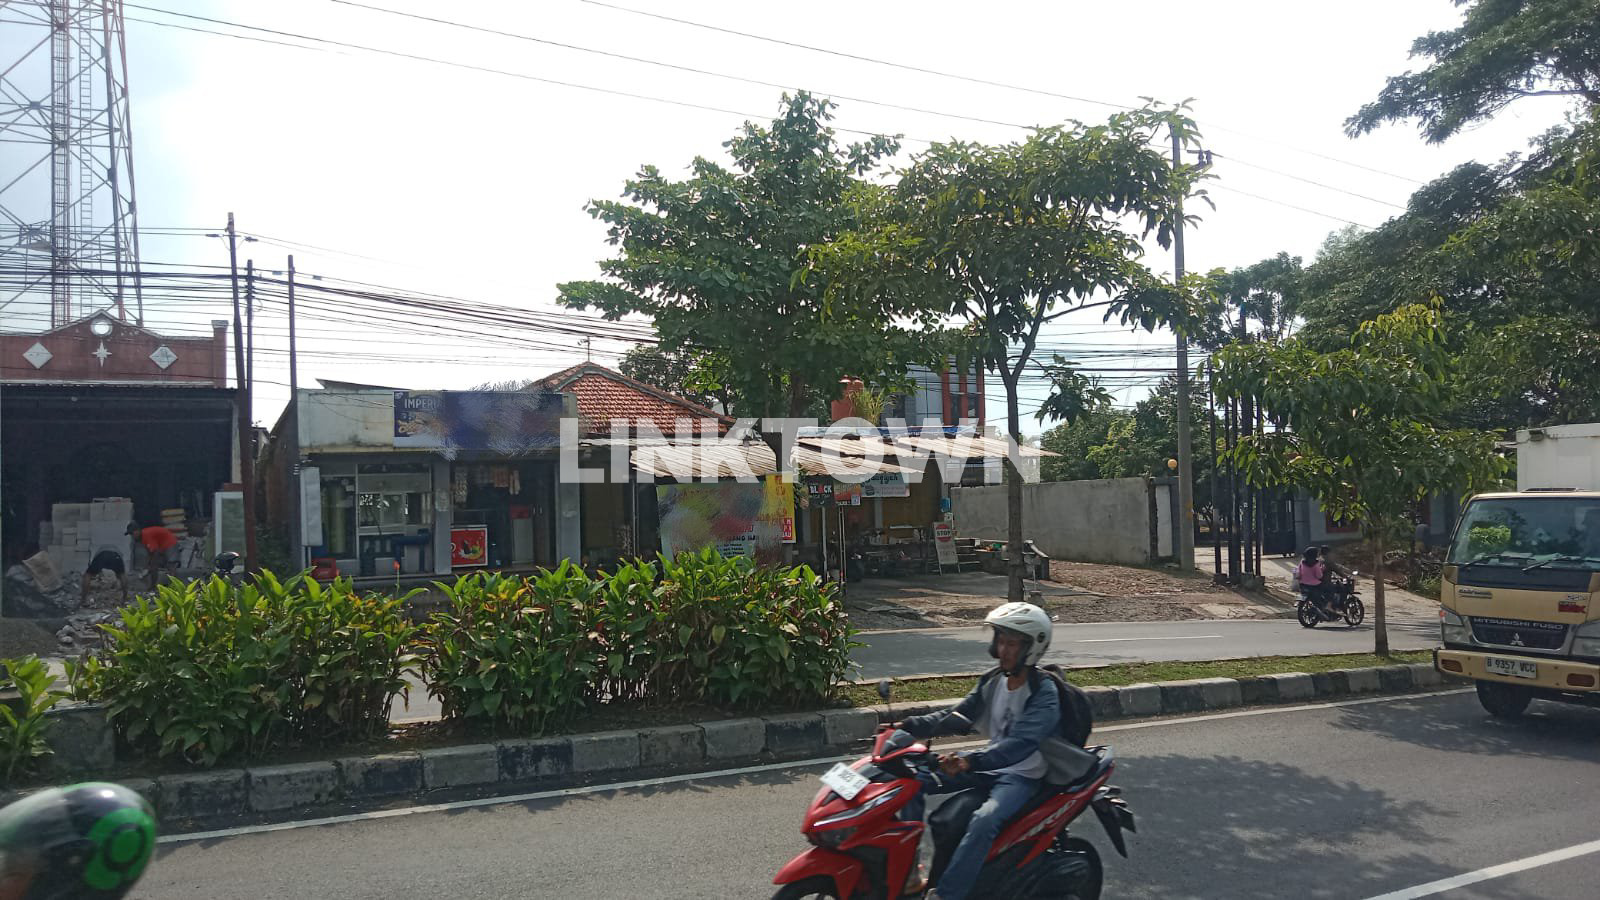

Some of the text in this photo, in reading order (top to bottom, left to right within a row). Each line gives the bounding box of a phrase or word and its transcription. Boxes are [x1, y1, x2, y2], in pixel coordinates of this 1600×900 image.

[936, 529, 951, 537] STOP
[1473, 617, 1564, 631] MITSUBISHI FUSO
[1495, 659, 1516, 670] 9357
